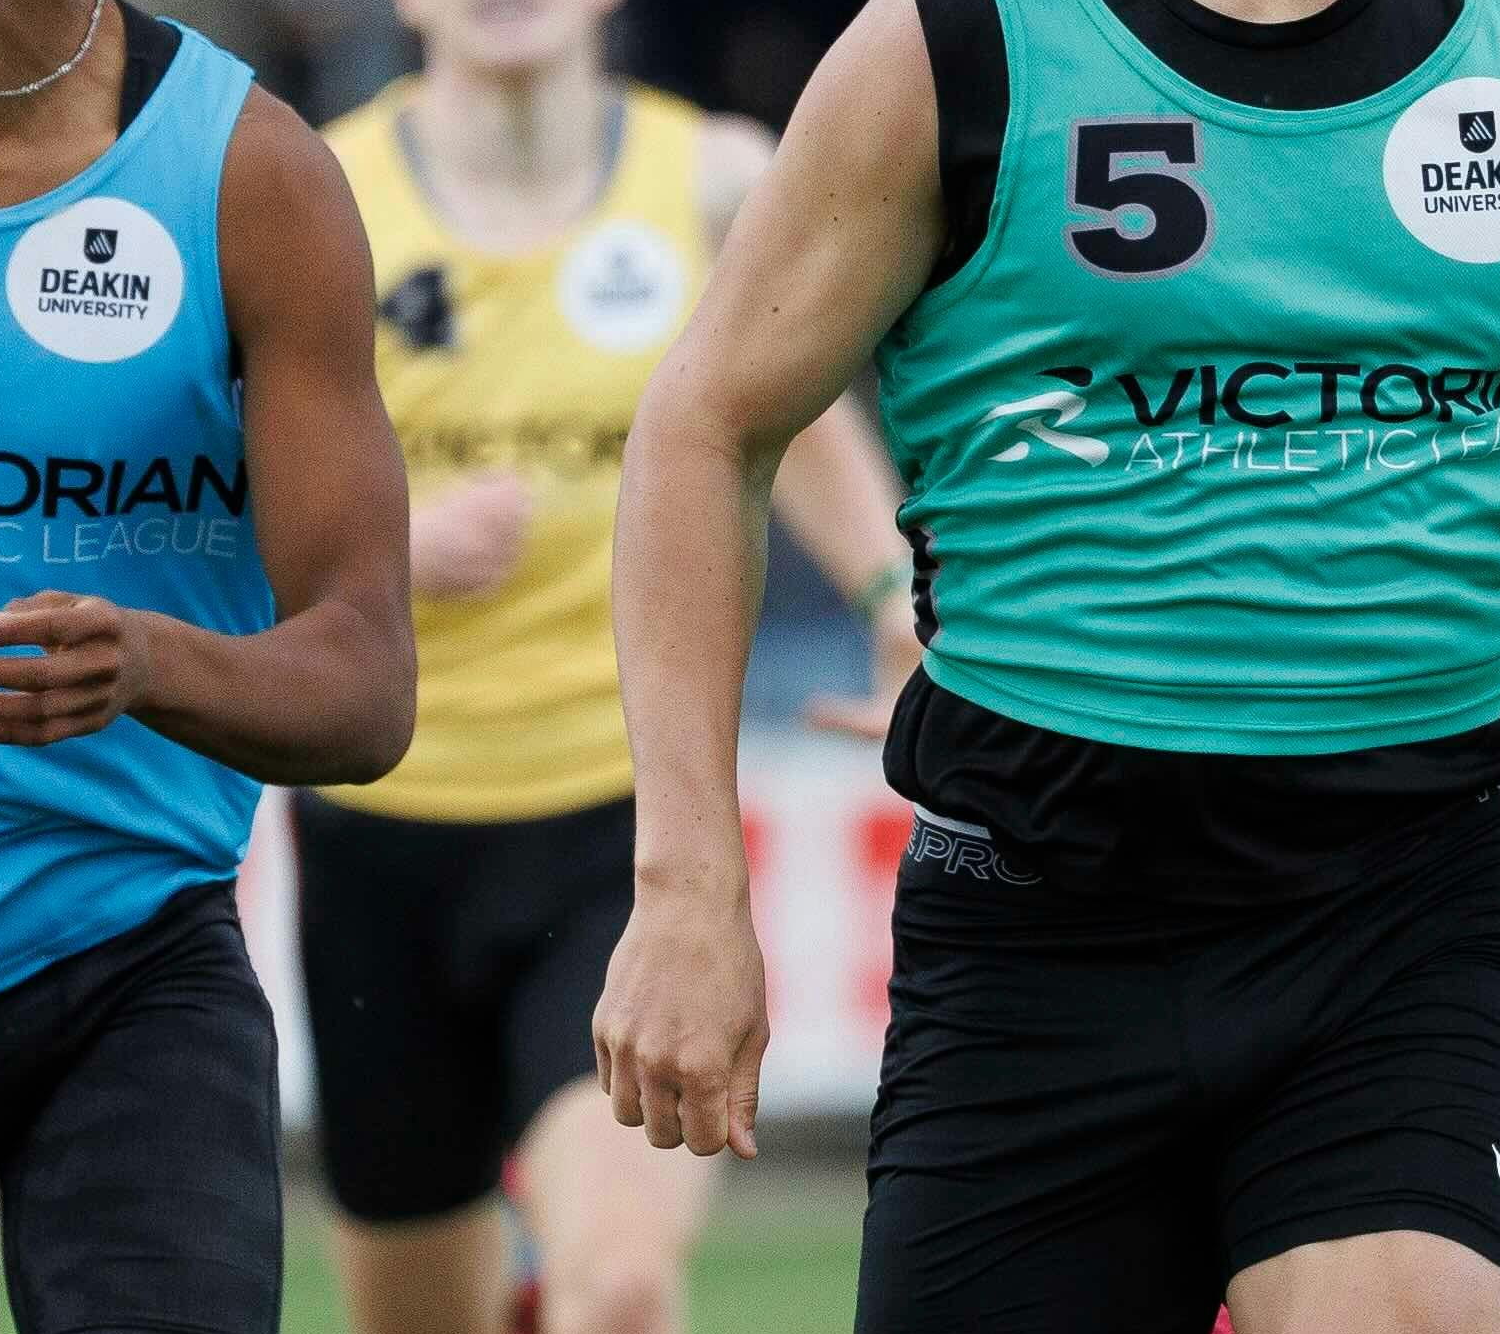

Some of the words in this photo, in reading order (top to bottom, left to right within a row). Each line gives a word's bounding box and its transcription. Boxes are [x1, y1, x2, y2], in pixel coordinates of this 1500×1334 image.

[1067, 120, 1211, 278] 5
[39, 267, 151, 301] DEAKIN
[38, 297, 149, 321] UNIVERSITY
[1124, 428, 1418, 473] ATHLETIC
[42, 515, 240, 565] LEAGUE
